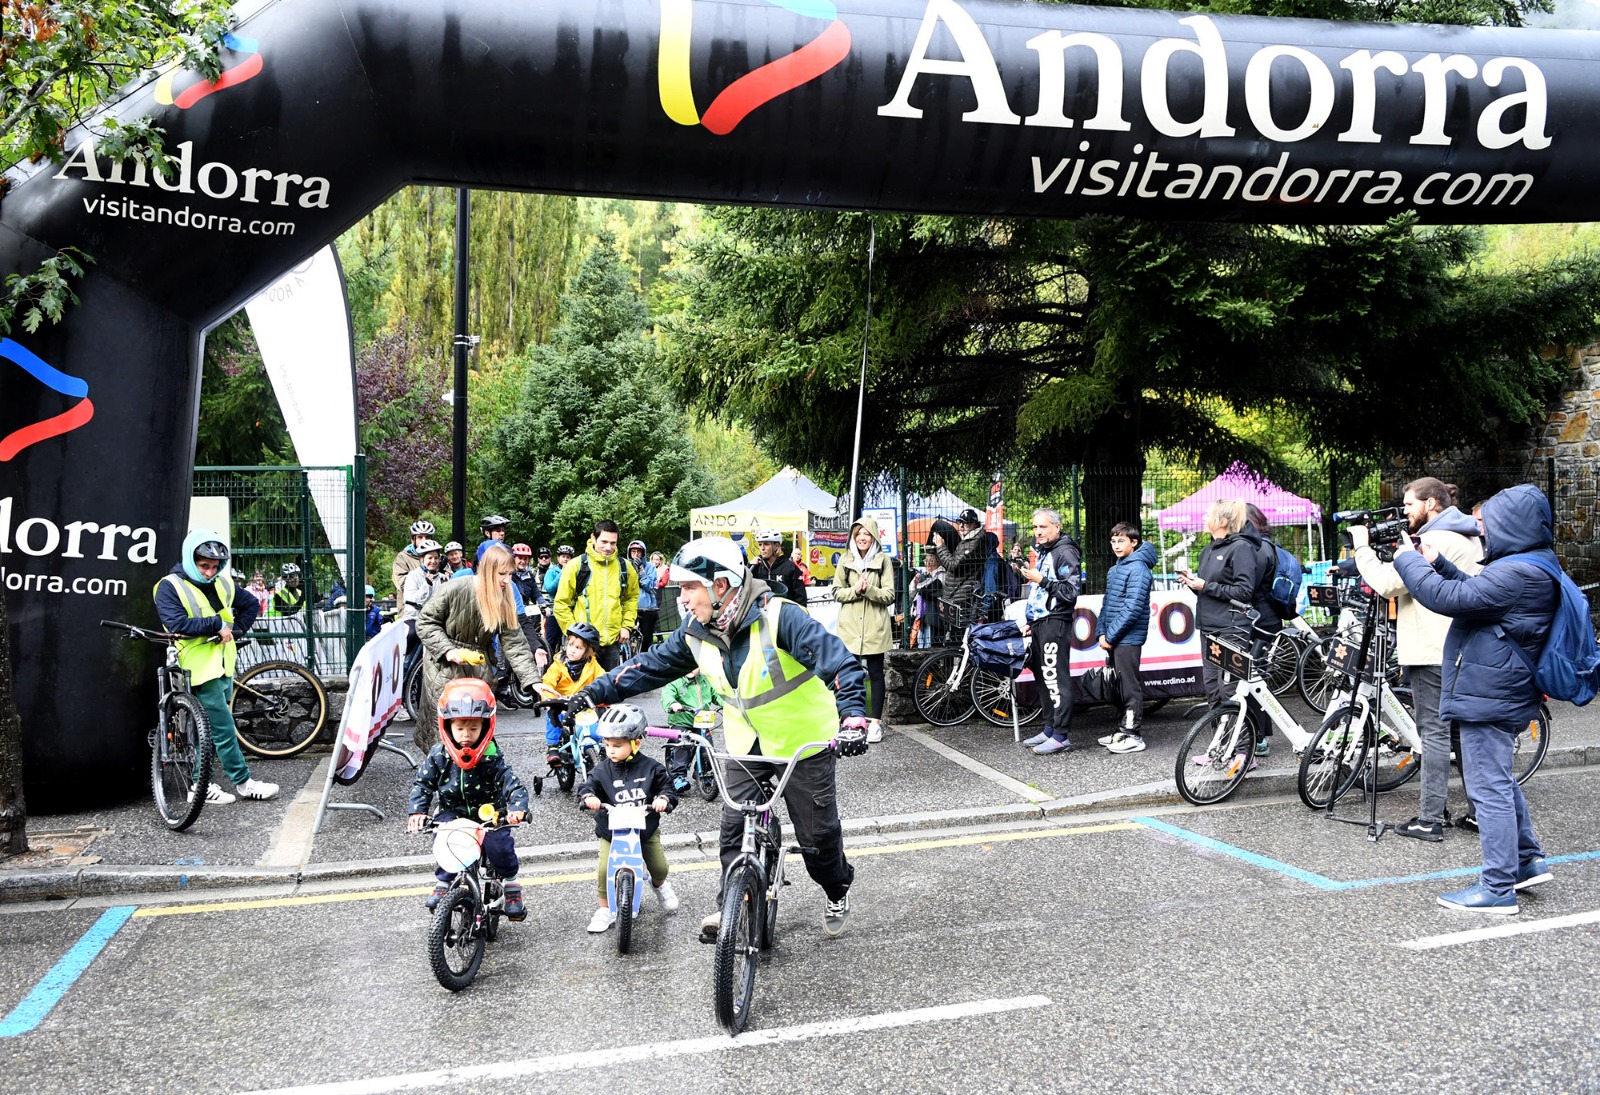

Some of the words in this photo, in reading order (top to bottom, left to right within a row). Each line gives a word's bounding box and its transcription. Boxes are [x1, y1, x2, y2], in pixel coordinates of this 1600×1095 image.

[877, 0, 1553, 151] Andorra
[1031, 140, 1535, 207] visitandorra.com
[83, 194, 296, 236] visitandorra.com
[813, 514, 835, 529] ENJOY
[0, 566, 128, 596] orra.com
[1144, 675, 1196, 687] www.ordino.ad
[614, 787, 647, 802] CAJA
